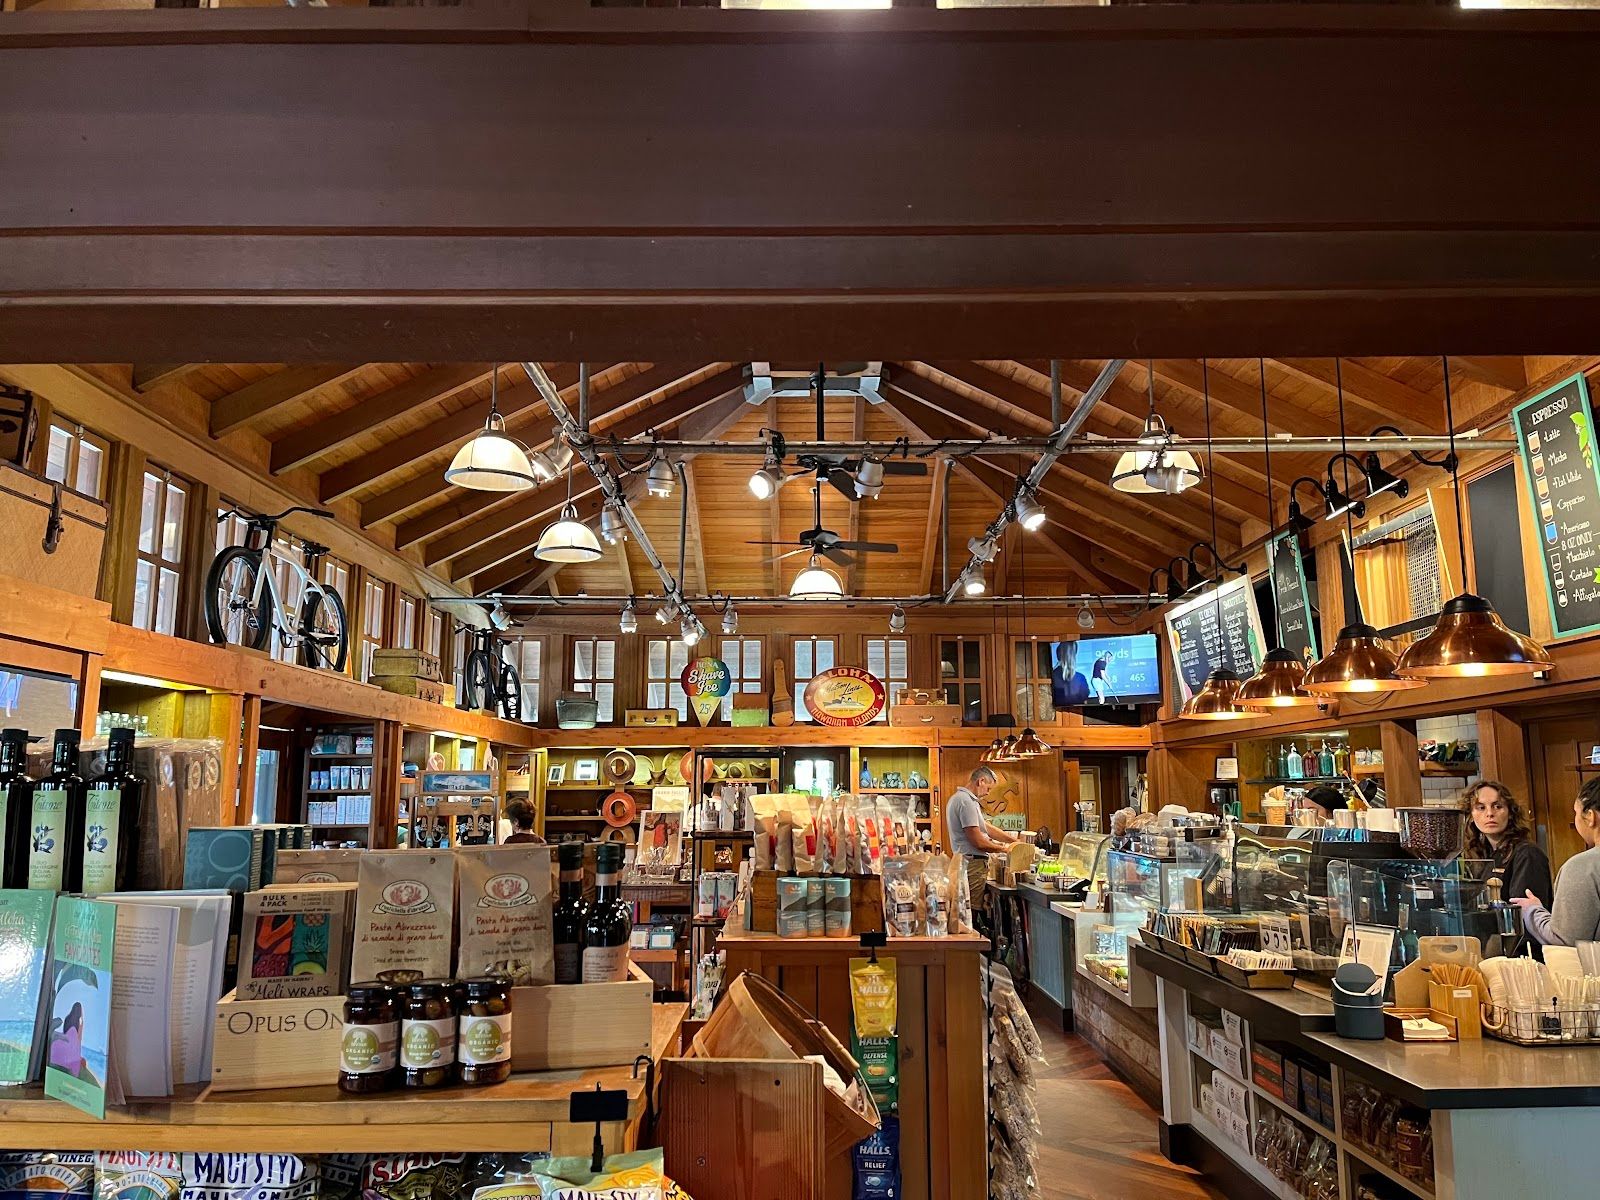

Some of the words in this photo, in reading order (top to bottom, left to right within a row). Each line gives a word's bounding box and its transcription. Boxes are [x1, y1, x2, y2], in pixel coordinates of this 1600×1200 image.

[1531, 397, 1568, 425] ESPRESSO
[1545, 429, 1560, 442] Latte
[1549, 450, 1567, 466] Mocha
[1554, 476, 1566, 488] Flat
[1566, 469, 1582, 483] White
[1563, 520, 1590, 535] Americano
[1562, 541, 1566, 550] 8
[1568, 536, 1576, 548] OZ
[1576, 531, 1592, 546] ONLY
[1570, 568, 1592, 581] Cortado
[688, 669, 725, 684] Shave
[815, 668, 874, 684] ALOHA
[1130, 673, 1146, 682] 465
[696, 680, 718, 695] Ice
[852, 706, 880, 726] ISLANDS
[1000, 818, 1022, 828] X-ING
[370, 922, 392, 931] Pasta
[476, 916, 497, 925] Pasta
[371, 933, 394, 941] semola
[406, 936, 426, 944] grano
[428, 932, 444, 940] duro
[478, 926, 500, 935] semola
[512, 926, 531, 936] grano
[250, 984, 284, 1000] Meli
[287, 985, 330, 998] WRAPS
[858, 985, 889, 994] HALLS
[228, 1011, 296, 1034] OPUS
[304, 1008, 344, 1031] ON
[859, 1037, 889, 1046] HALLS
[860, 1146, 890, 1155] HALLS
[26, 1154, 34, 1162] &
[58, 1154, 94, 1163] VINEG
[194, 1152, 248, 1184] MAUI
[259, 1183, 312, 1200] ONION
